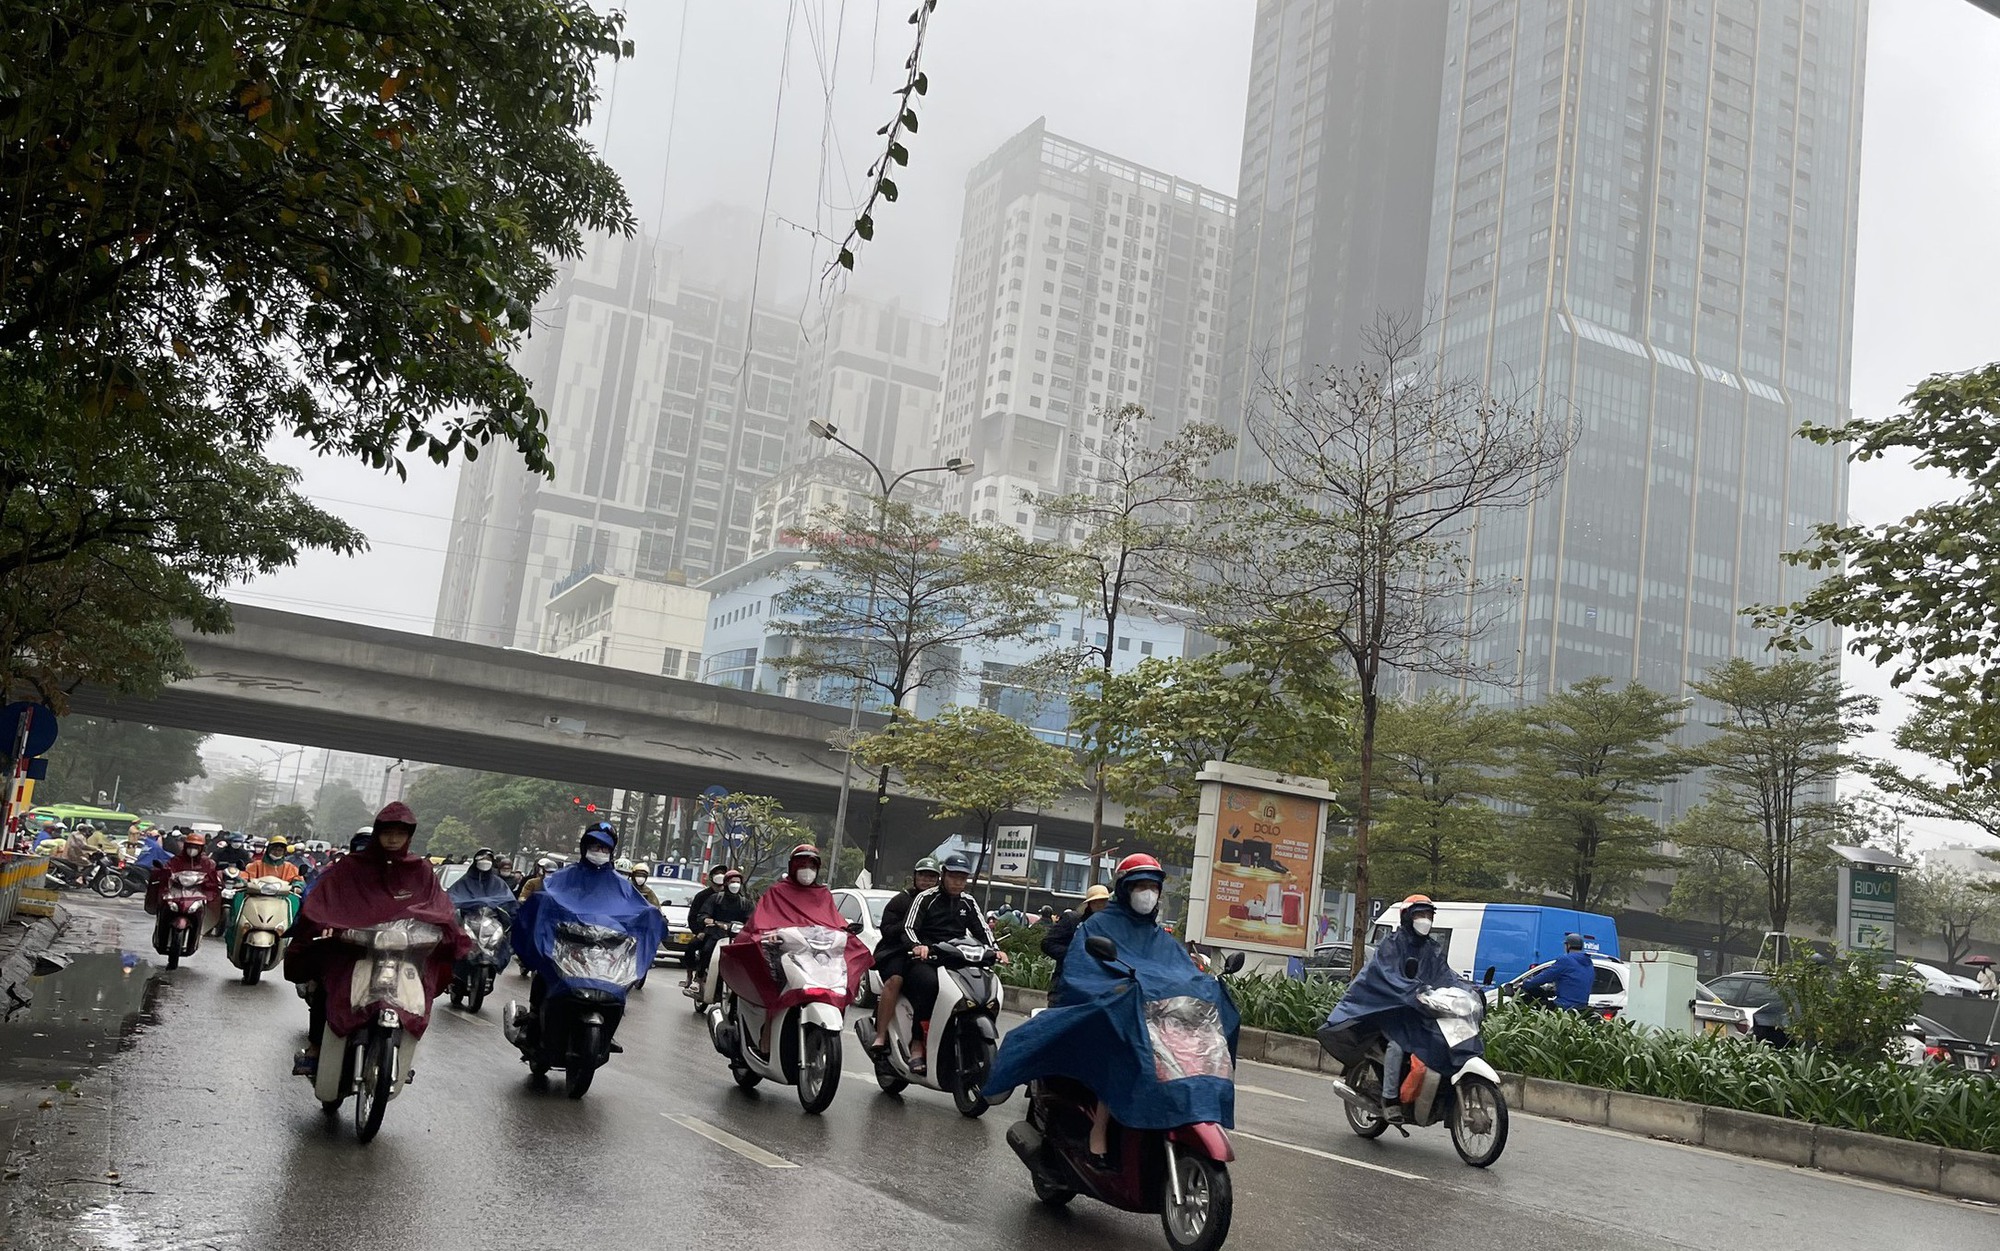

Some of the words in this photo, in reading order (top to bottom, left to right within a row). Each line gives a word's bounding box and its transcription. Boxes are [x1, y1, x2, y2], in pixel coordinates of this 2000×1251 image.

[1254, 822, 1280, 836] DOLO
[1854, 880, 1881, 896] BIDV
[1373, 901, 1381, 917] P
